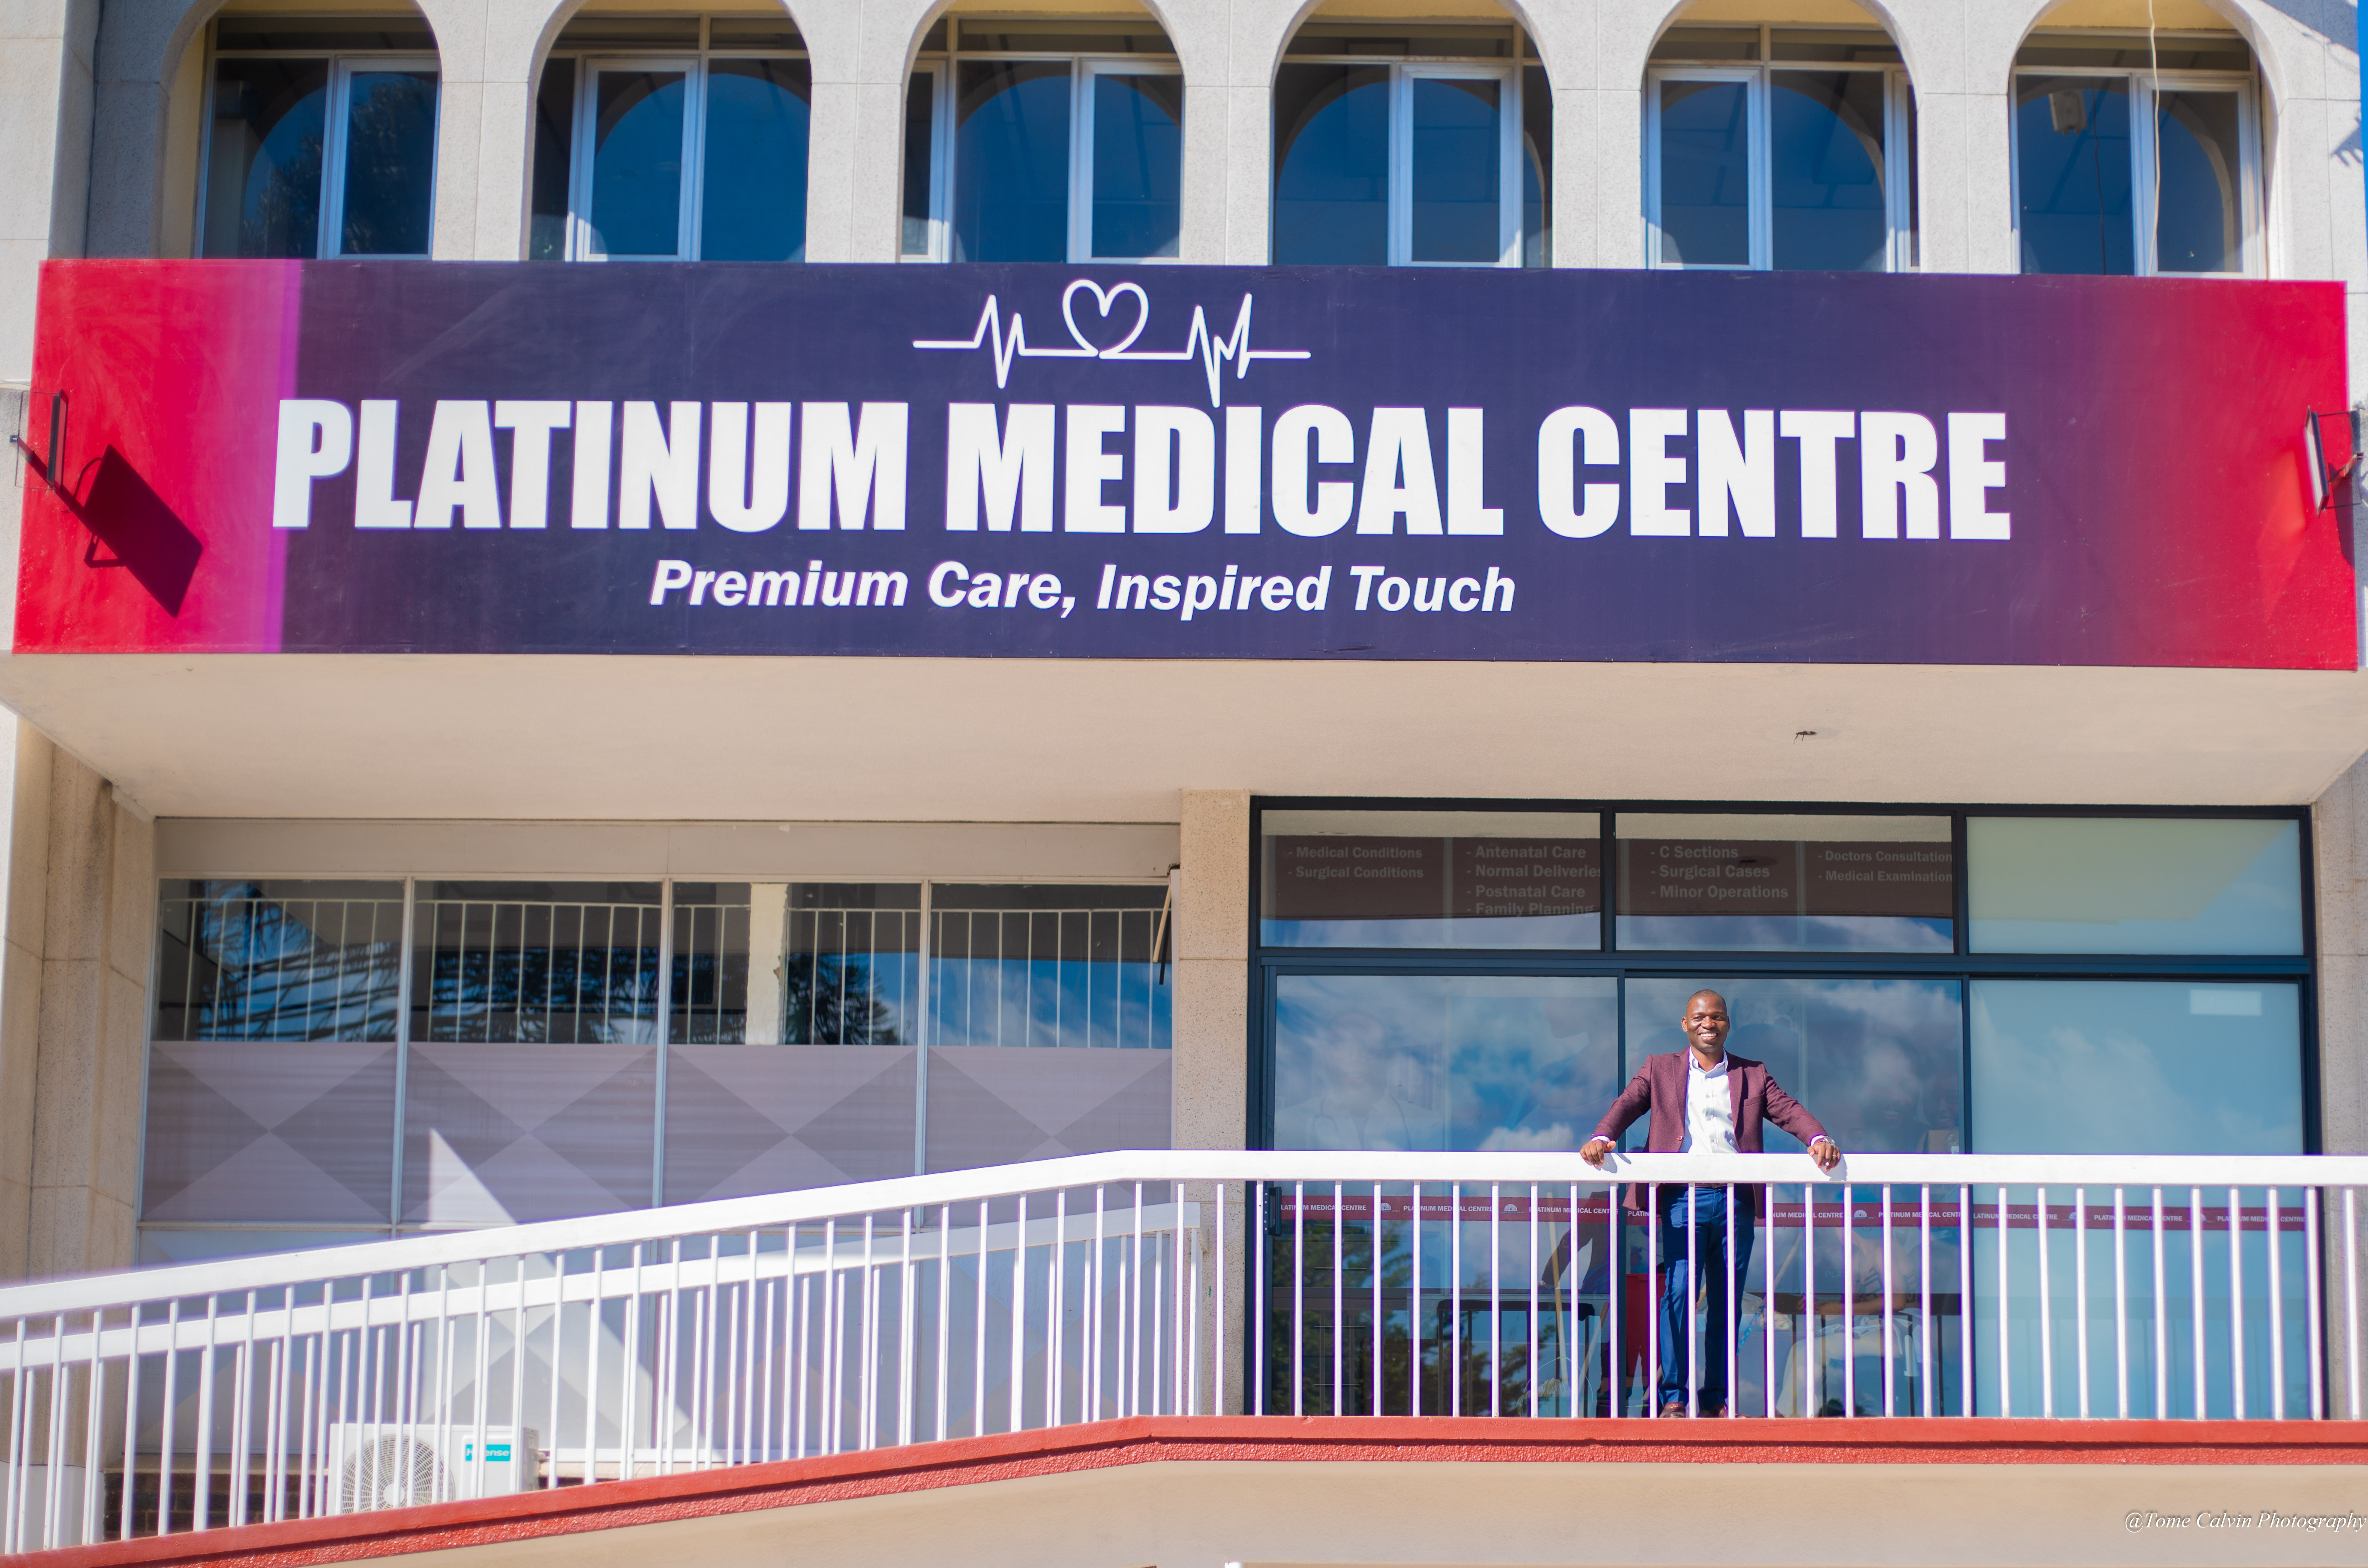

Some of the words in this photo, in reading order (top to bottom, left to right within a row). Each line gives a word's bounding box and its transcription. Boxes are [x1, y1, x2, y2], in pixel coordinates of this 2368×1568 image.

[273, 399, 908, 532] PLATINUM
[946, 403, 1503, 537] MEDICAL
[1539, 407, 2010, 540] CENTRE
[650, 560, 908, 606] Premium
[929, 561, 1075, 618] Care,
[1097, 564, 1332, 620] Inspired
[1350, 566, 1515, 612] Touch
[1296, 846, 1349, 858] Medical
[1352, 847, 1422, 859] Conditions
[1475, 845, 1548, 859] Antenatal
[1552, 845, 1587, 859] Care
[1659, 845, 1670, 858] C
[1674, 845, 1739, 859] Sections
[1825, 850, 1872, 861] Doctors
[1876, 851, 1952, 862] Consultation
[1296, 866, 1350, 880] Surgical
[1353, 866, 1424, 878] Conditions
[1476, 864, 1528, 877] Normal
[1659, 865, 1720, 880] Surgical
[1725, 865, 1770, 878] Cases
[1826, 870, 1874, 881] Medical
[1878, 871, 1952, 882] Examination
[1476, 885, 1546, 898] Postnatal
[1551, 885, 1585, 898] Care
[1660, 885, 1703, 898] Minor
[1707, 885, 1789, 901] Operations
[1476, 902, 1525, 916] Family
[1529, 902, 1594, 917] Planning
[466, 1448, 510, 1456] Hense
